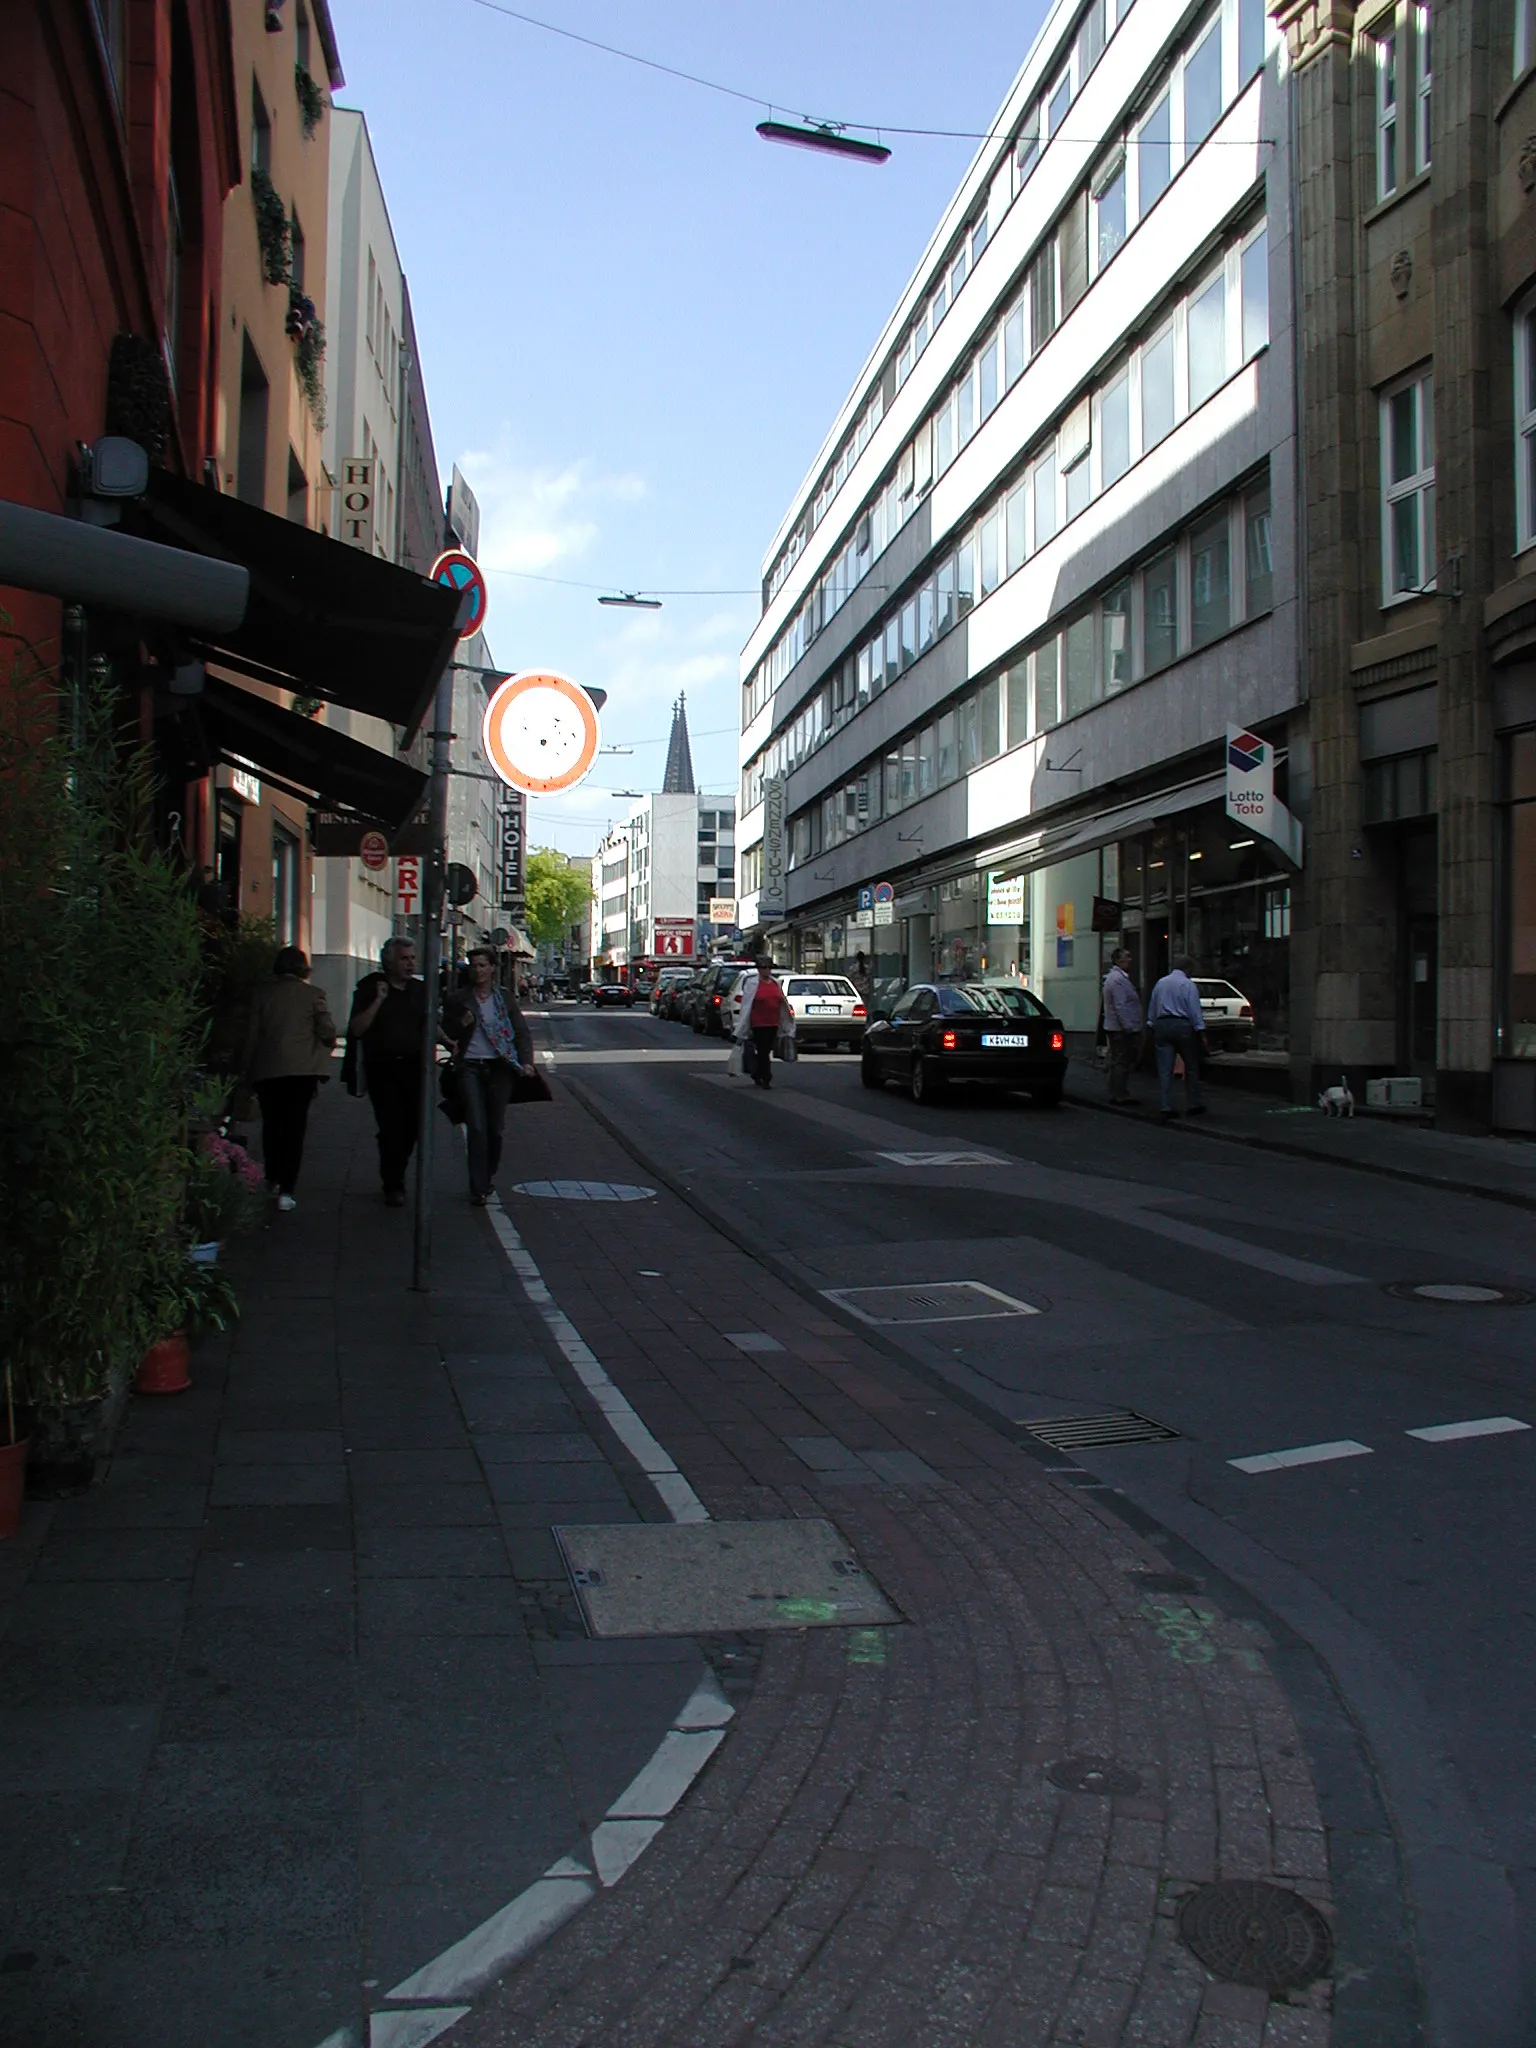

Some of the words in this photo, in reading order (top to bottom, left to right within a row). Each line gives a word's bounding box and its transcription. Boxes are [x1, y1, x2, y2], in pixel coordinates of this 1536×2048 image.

[345, 465, 370, 550] HOT
[1229, 791, 1264, 802] Lotto
[1234, 803, 1264, 814] Toto
[504, 814, 520, 891] HOTEL
[768, 780, 783, 897] SONNENSTUDIO
[861, 891, 871, 909] P
